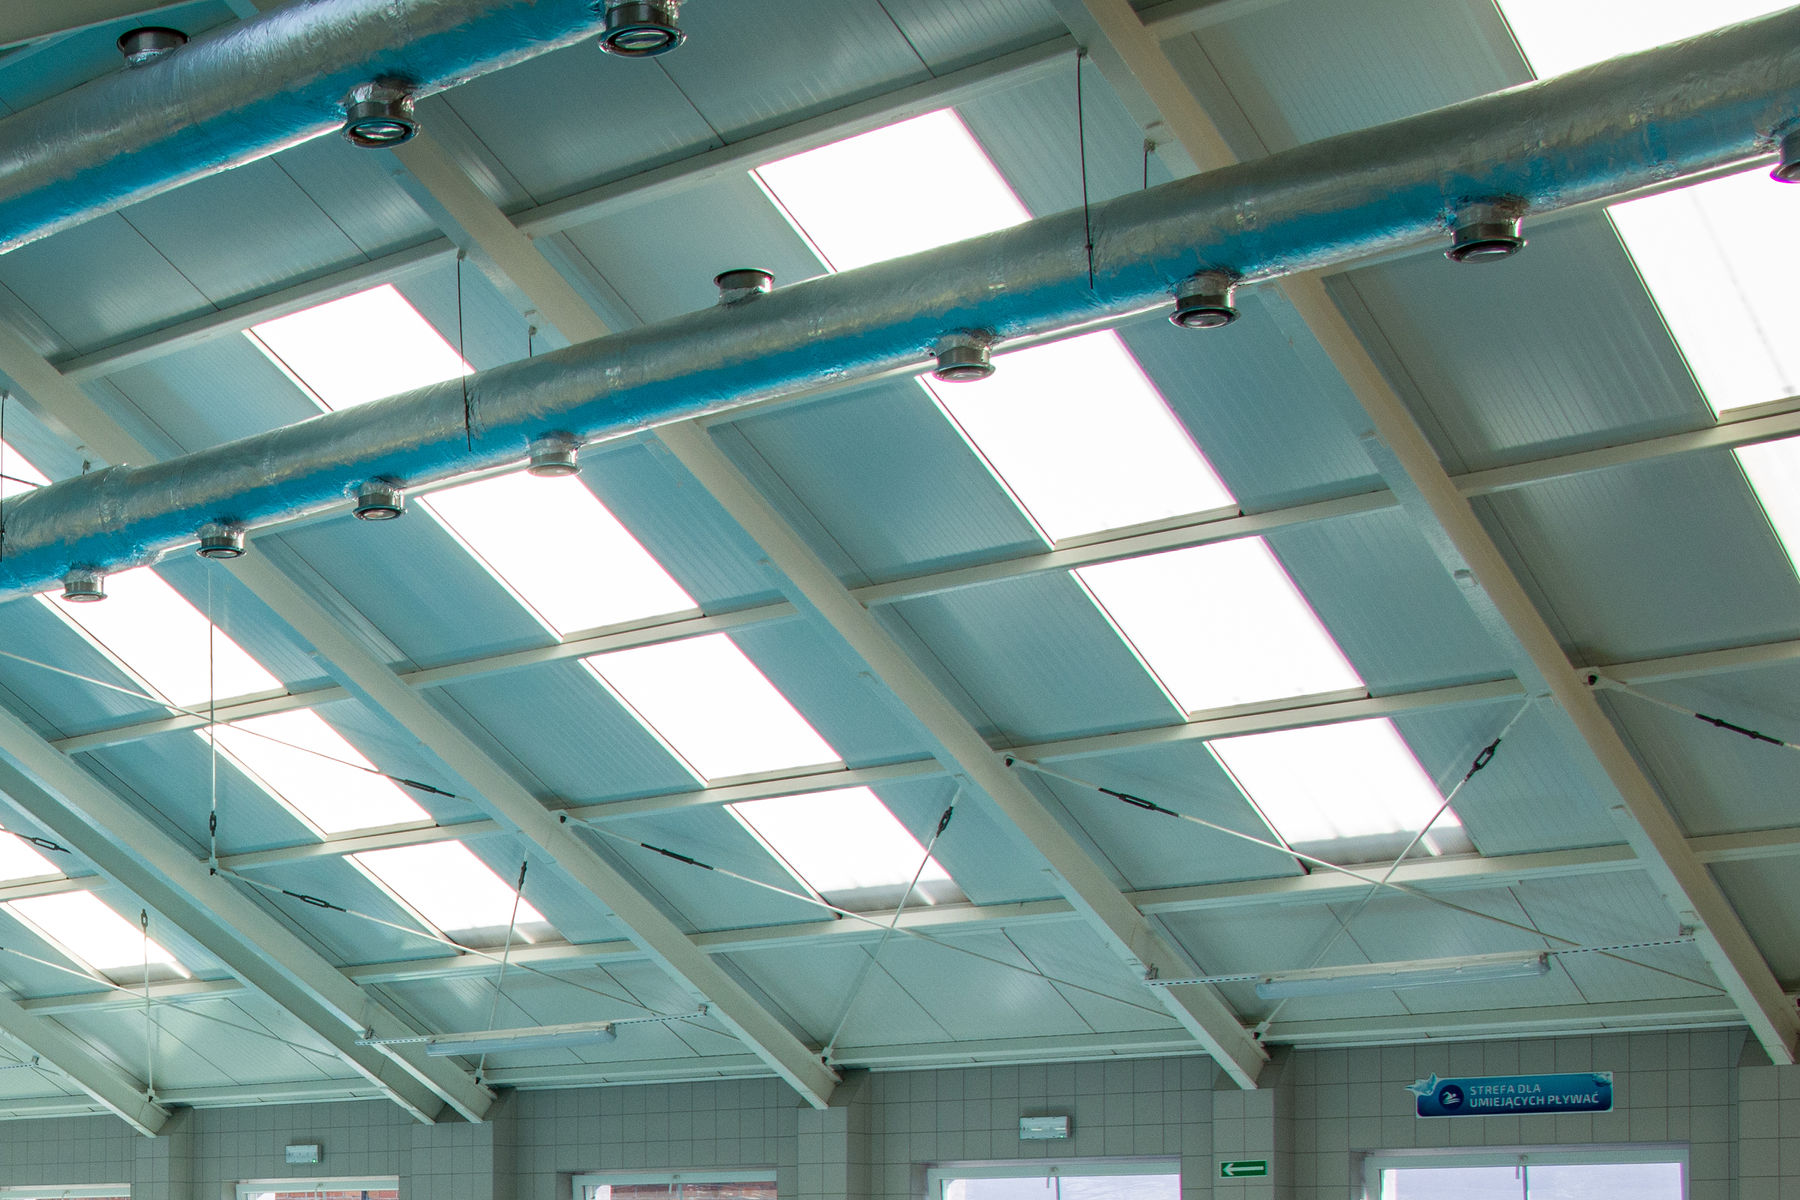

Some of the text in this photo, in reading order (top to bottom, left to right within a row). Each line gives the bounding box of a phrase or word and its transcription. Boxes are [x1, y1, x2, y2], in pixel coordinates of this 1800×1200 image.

[1469, 1083, 1541, 1096] STREFA DLA
[1469, 1093, 1600, 1109] UMIEJĄCYCH PŁYWAĆ
